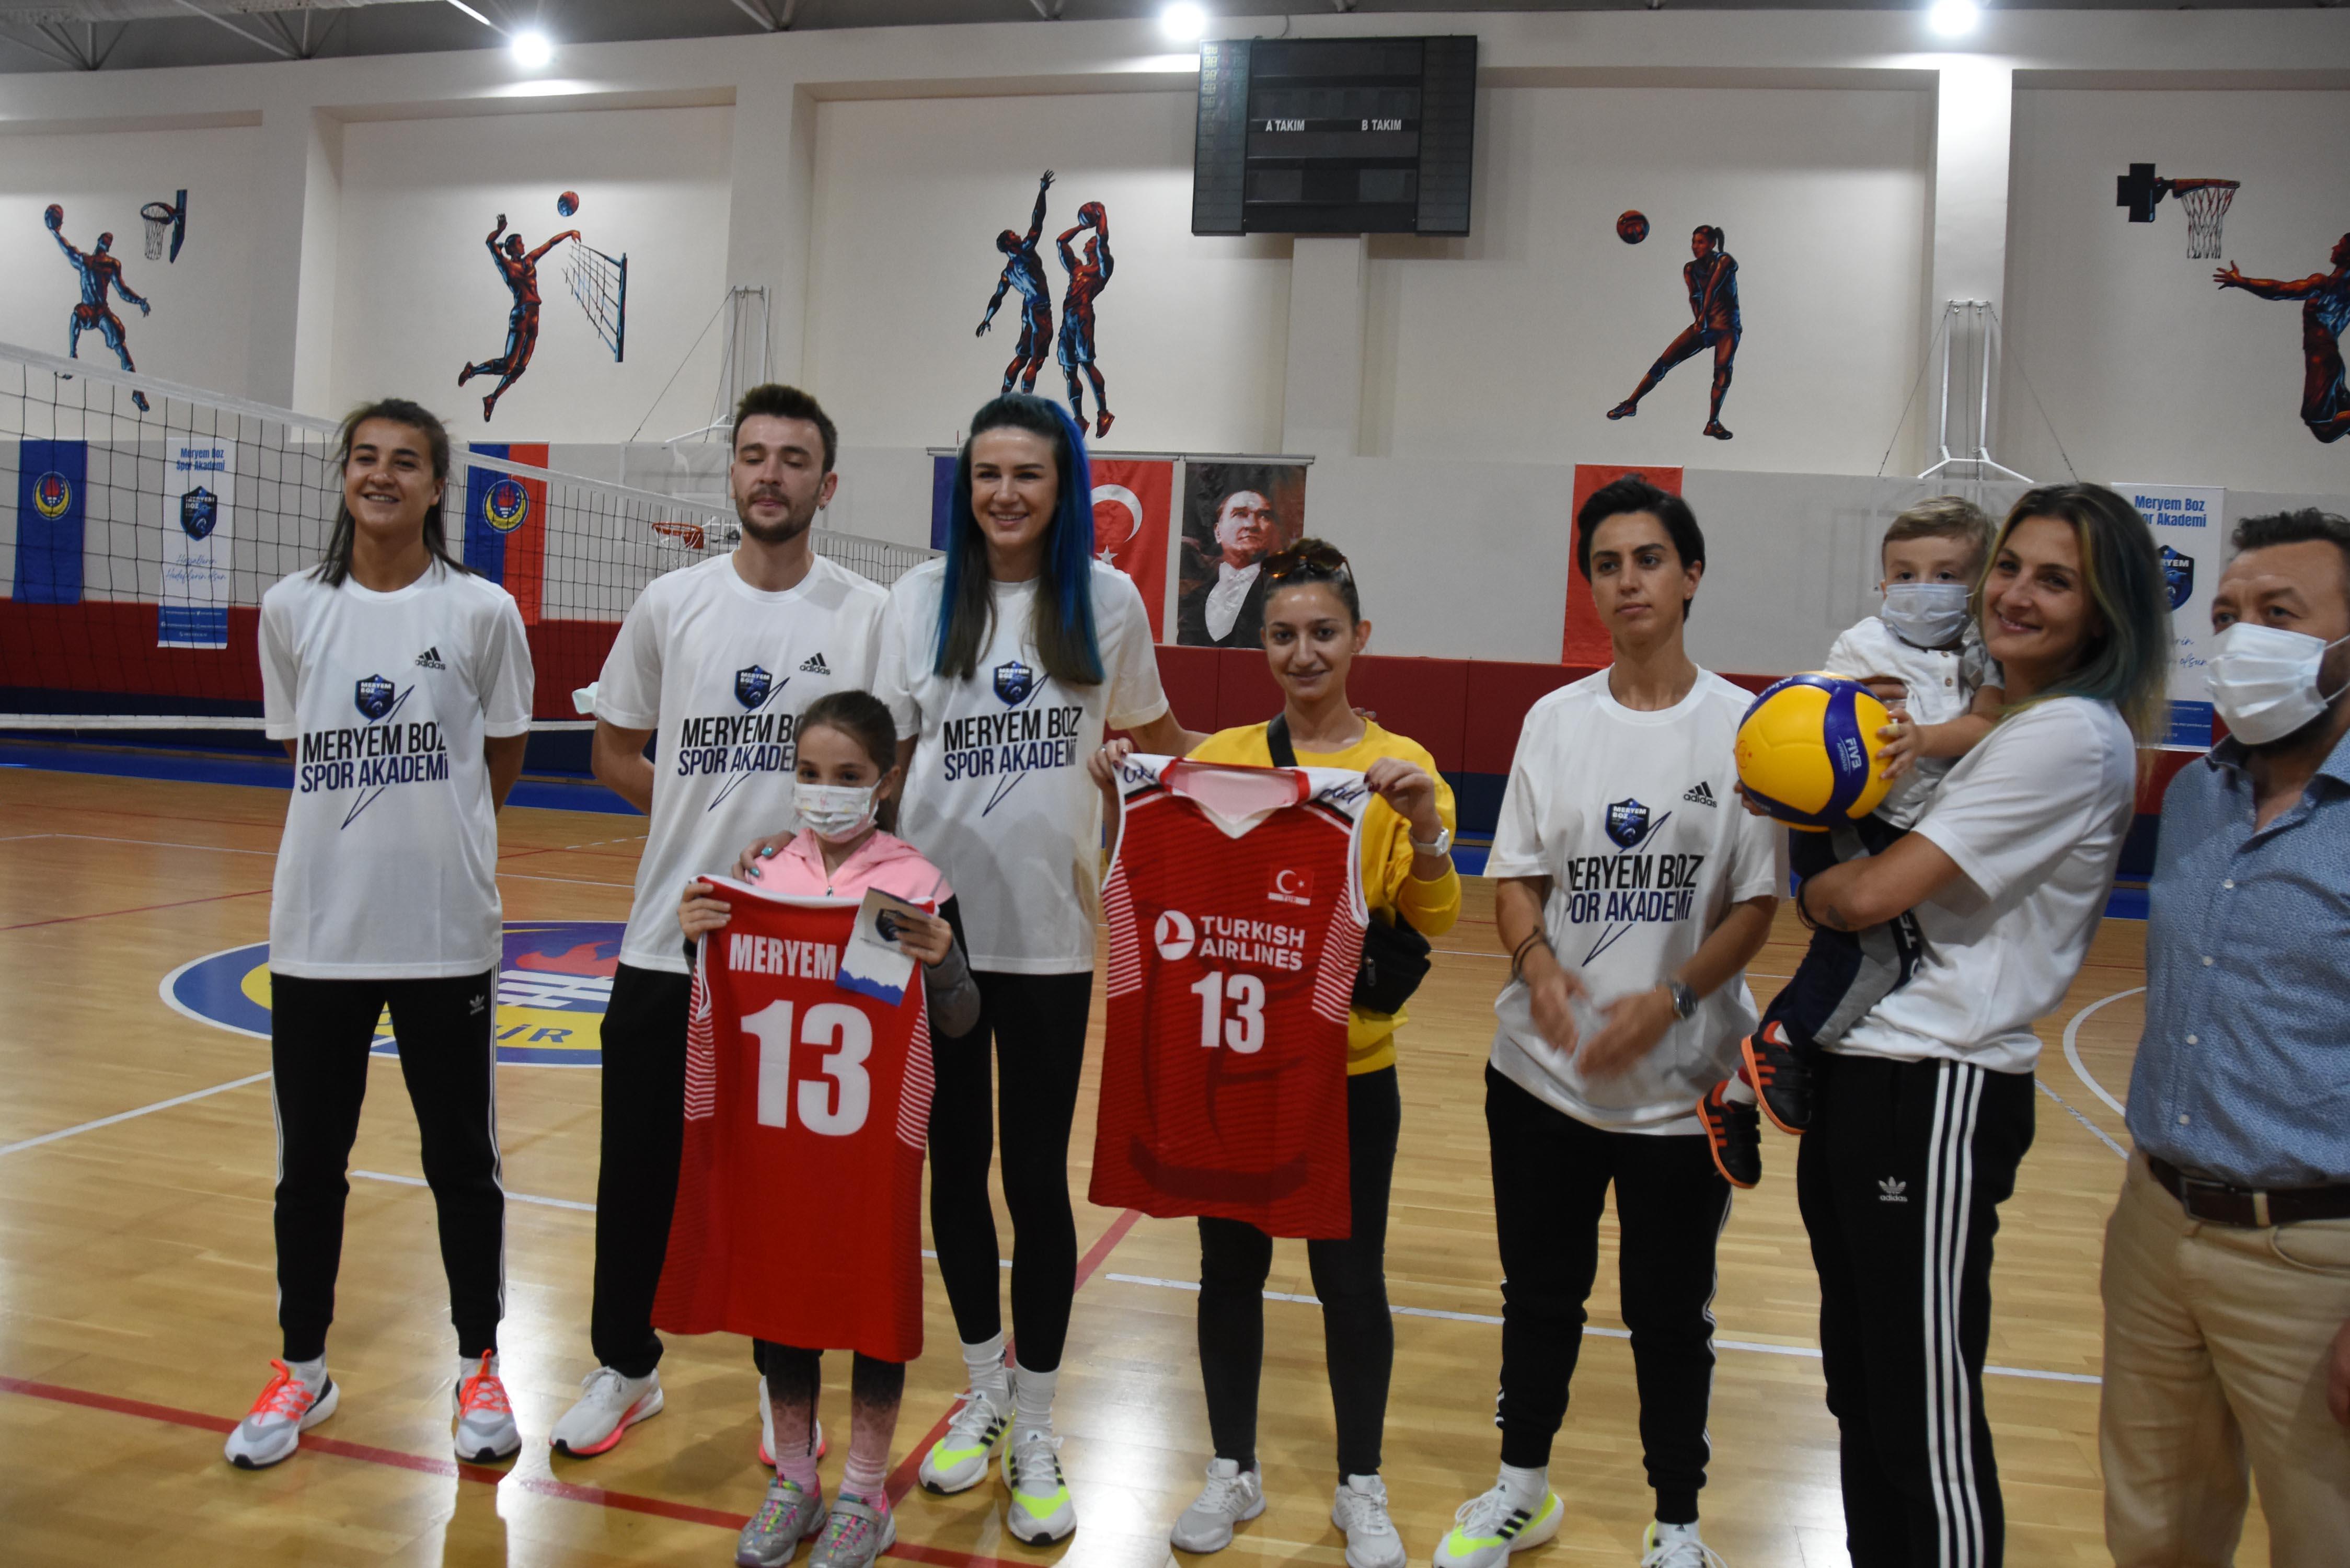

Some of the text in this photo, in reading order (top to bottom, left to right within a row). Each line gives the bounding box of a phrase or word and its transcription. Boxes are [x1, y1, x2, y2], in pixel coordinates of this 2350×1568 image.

[1265, 120, 1305, 131] A TAKIM
[1361, 119, 1402, 131] B TAKIM
[2135, 495, 2205, 512] Meryem Boz
[2157, 512, 2207, 527] Akademi
[415, 658, 446, 671] adidas
[799, 663, 831, 675] adidas
[303, 723, 402, 764] MERYEM
[681, 713, 775, 747] MERYEM
[943, 707, 1083, 752] MERYEM BOZ
[678, 748, 728, 776] SPOR
[944, 747, 994, 781] SPOR
[1845, 737, 1862, 769] FIVB
[301, 760, 354, 793] SPOR
[1613, 805, 1647, 815] MERYEM
[1683, 792, 1718, 808] adidas
[1657, 853, 1705, 889] BOZ
[1200, 915, 1306, 948] TURKISH
[729, 933, 837, 981] MERYEM
[1199, 938, 1303, 971] AIRLINES
[1191, 971, 1265, 1054] 13
[740, 999, 873, 1136] 13
